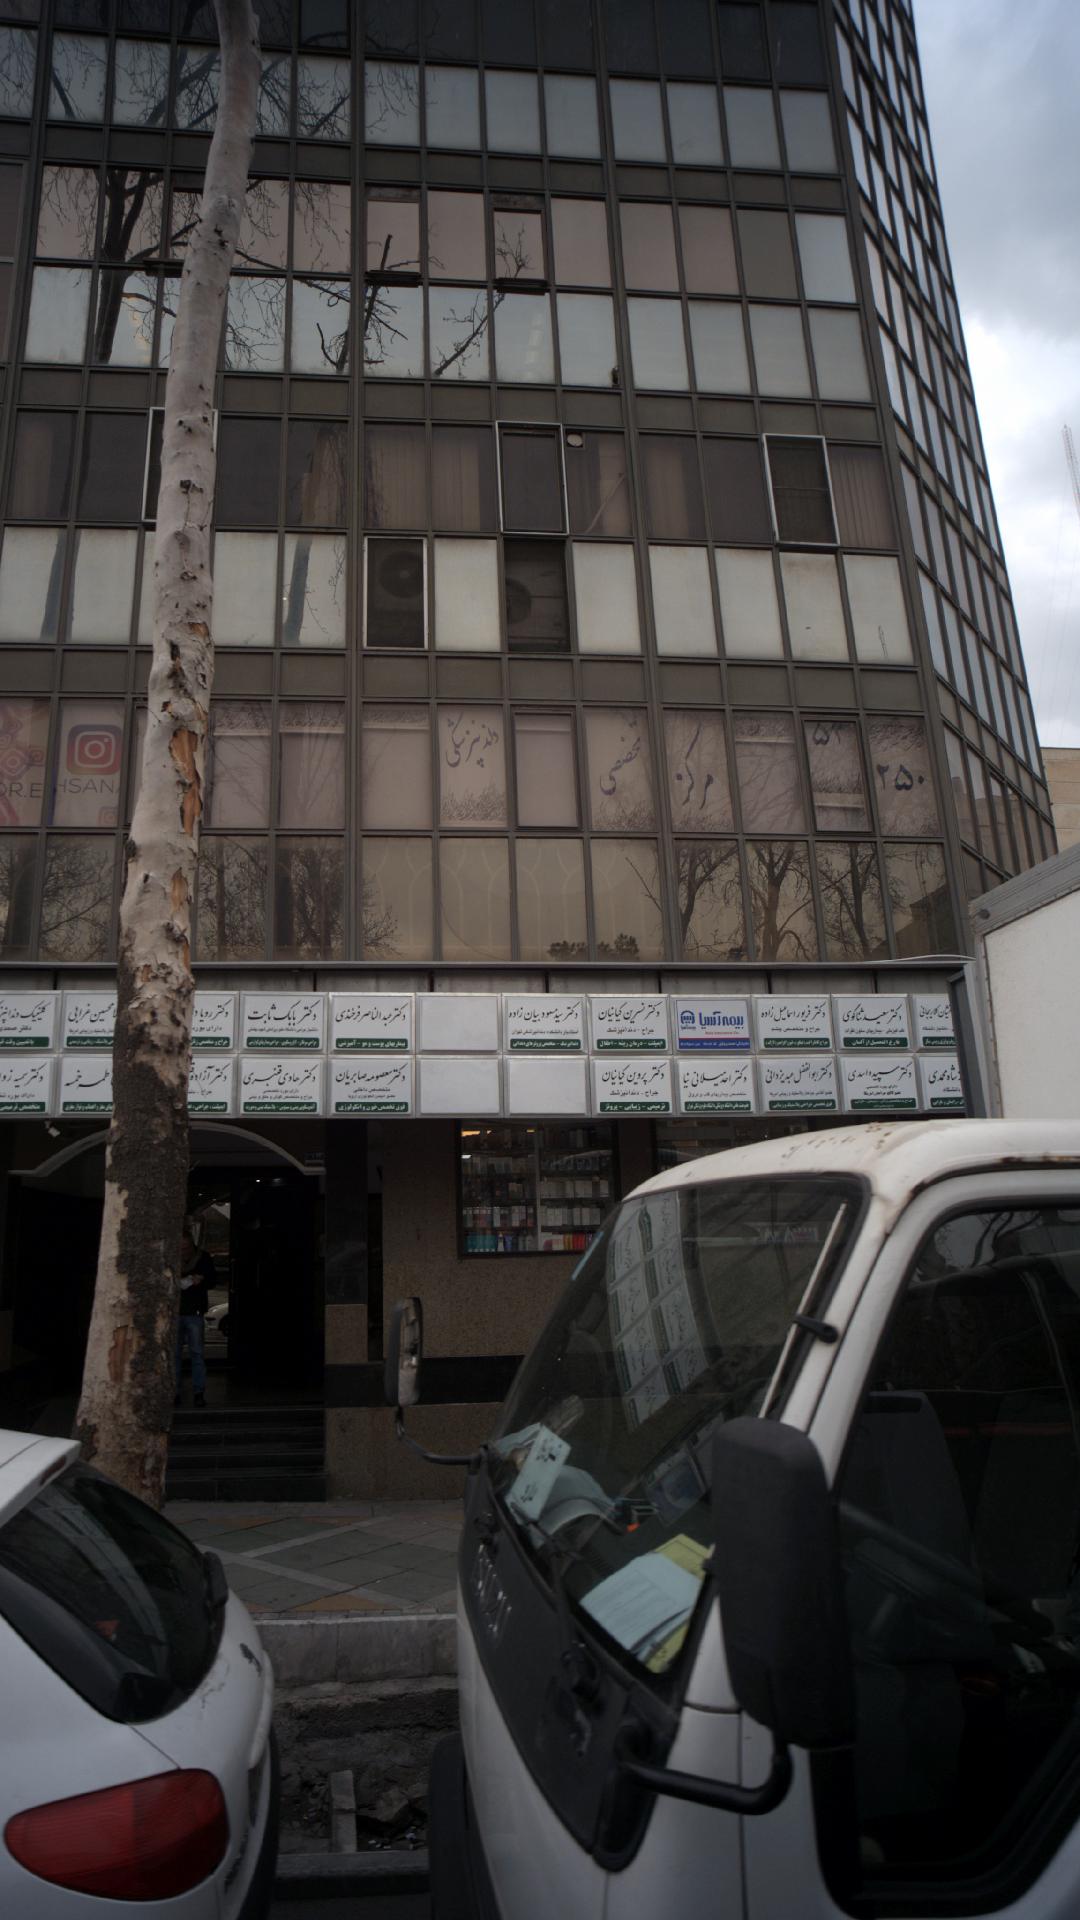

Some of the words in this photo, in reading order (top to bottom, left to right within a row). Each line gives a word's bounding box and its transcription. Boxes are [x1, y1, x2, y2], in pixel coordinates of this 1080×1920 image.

[20, 1000, 52, 1022] کلینیک
[209, 999, 233, 1021] دکتر
[247, 1003, 276, 1024] ثابت
[273, 1000, 301, 1026] بابک
[296, 999, 321, 1025] دکتر
[388, 1002, 409, 1024] دکتر
[561, 1000, 581, 1022] دکتر
[598, 1002, 628, 1022] کیانیان
[623, 1002, 646, 1024] نسرین
[643, 1001, 663, 1021] دکتر
[698, 1011, 721, 1029] آسیا
[811, 1000, 827, 1021] دکتر
[863, 1011, 889, 1024] سعید
[887, 1004, 903, 1025] دکتر
[722, 1015, 744, 1029] بیمه
[13, 1073, 29, 1089] سید
[24, 1062, 48, 1087] دکتر
[209, 1063, 231, 1085] دکتر
[243, 1064, 282, 1087] قنبری
[278, 1072, 300, 1086] هادی
[299, 1064, 319, 1086] دکتر
[364, 1070, 393, 1083] معصومه
[386, 1063, 408, 1086] دکتر
[601, 1063, 631, 1086] کیانیان
[626, 1072, 648, 1086] پروین
[648, 1062, 668, 1083] دکتر
[731, 1065, 749, 1088] دکتر
[818, 1060, 833, 1081] دکتر
[898, 1061, 913, 1081] دکتر
[644, 1089, 659, 1098] جراح
